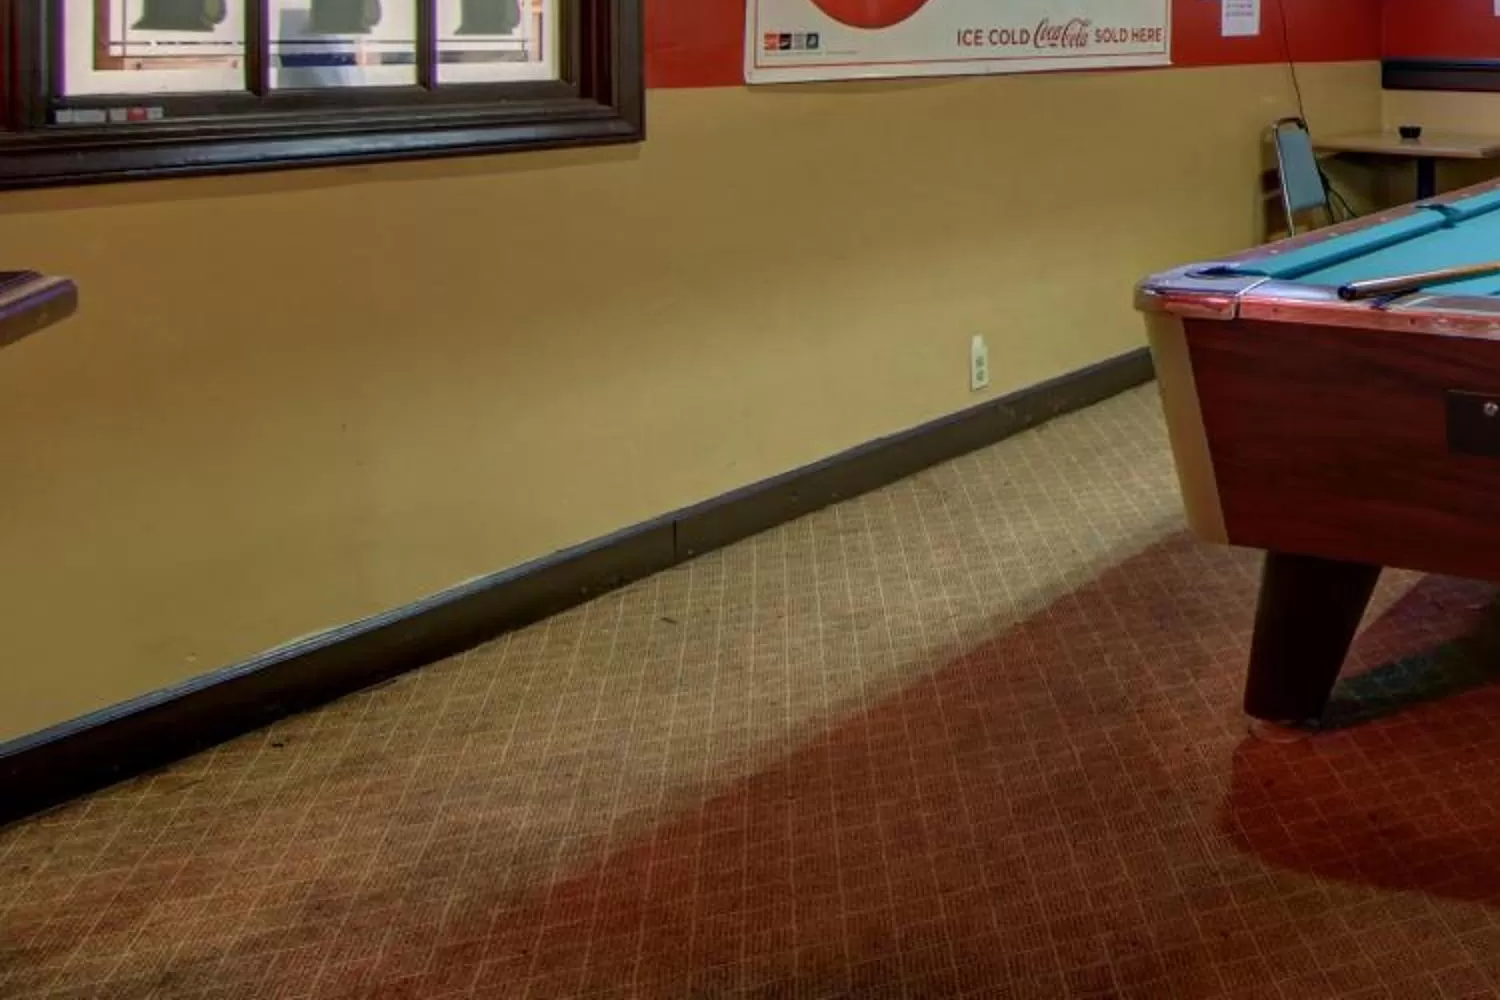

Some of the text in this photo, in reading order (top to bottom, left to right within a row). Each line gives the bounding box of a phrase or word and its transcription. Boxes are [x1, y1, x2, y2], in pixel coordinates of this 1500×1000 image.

[957, 28, 984, 47] ICE
[987, 28, 1031, 46] COLD
[1095, 27, 1128, 44] SOLD
[1131, 26, 1163, 44] HERE
